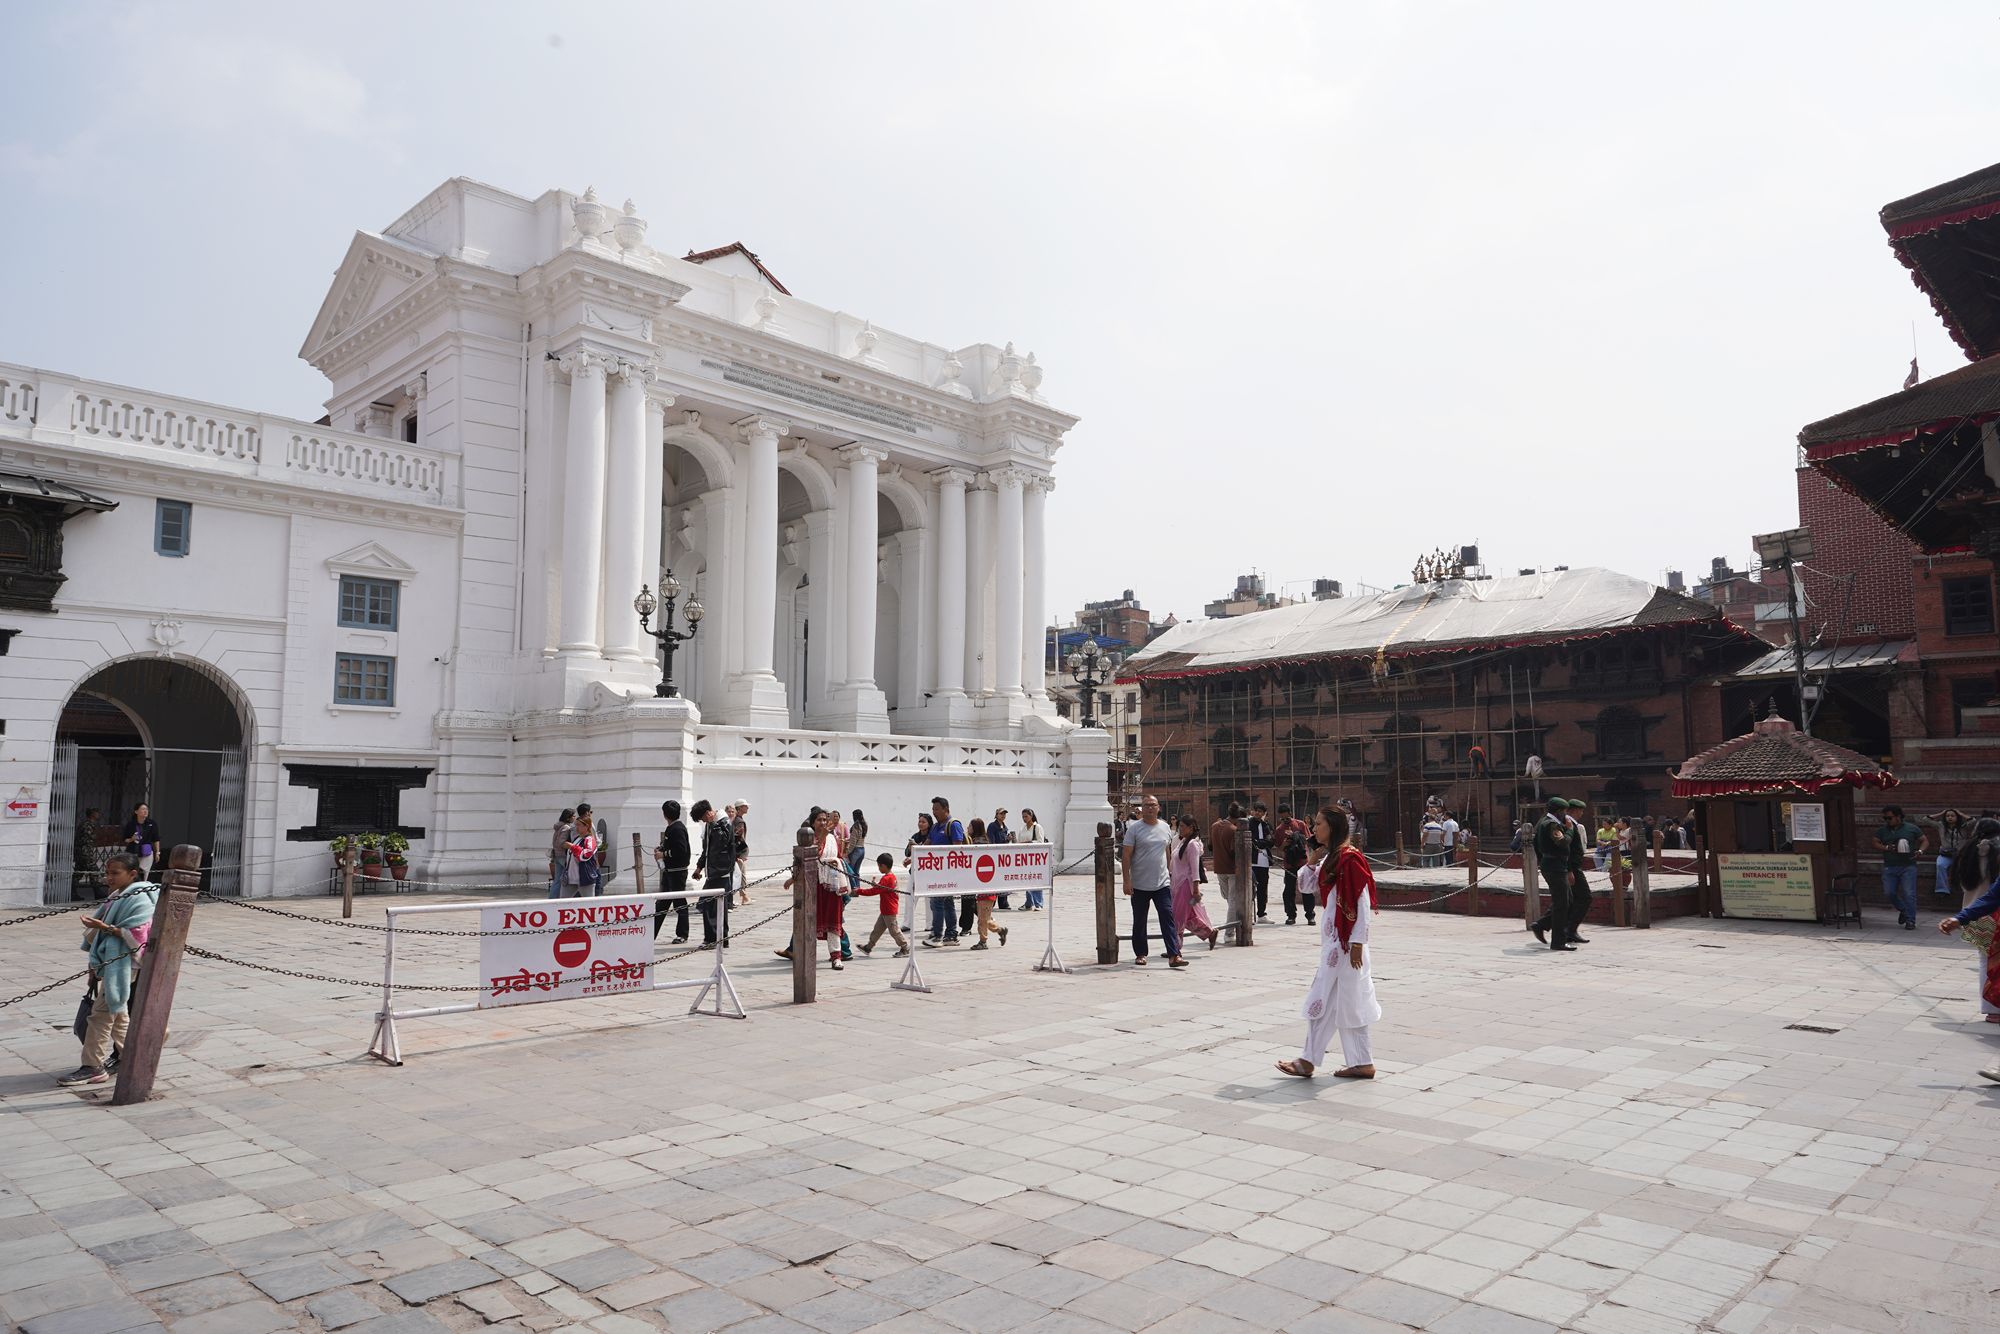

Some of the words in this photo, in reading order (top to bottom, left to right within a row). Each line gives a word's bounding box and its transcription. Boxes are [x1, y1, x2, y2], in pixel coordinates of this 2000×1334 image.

[917, 852, 943, 871] प्रवेश
[947, 850, 973, 869] निषेध
[998, 854, 1011, 867] NO
[1015, 852, 1048, 867] ENTRY
[502, 911, 547, 929] NO
[558, 904, 644, 925] ENTRY
[490, 967, 562, 997] प्रवेश
[590, 958, 646, 984] निषेध
